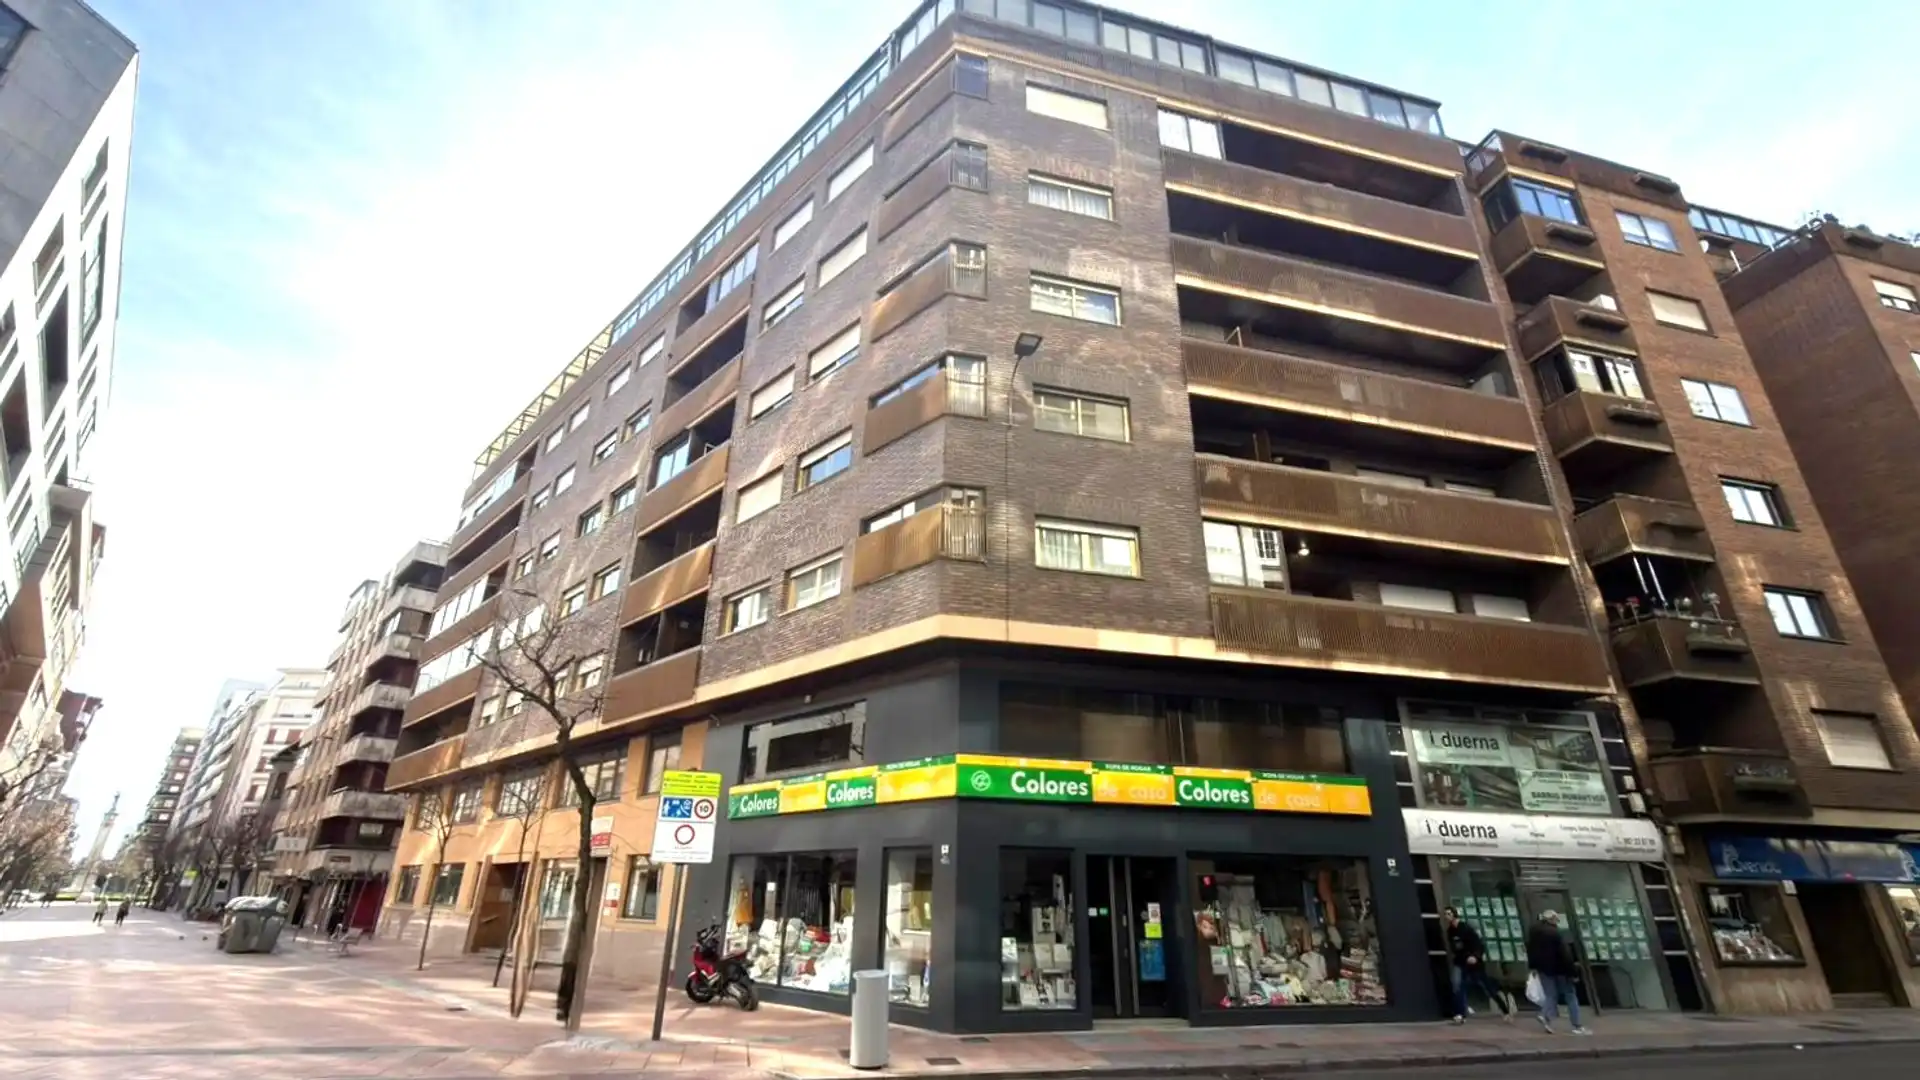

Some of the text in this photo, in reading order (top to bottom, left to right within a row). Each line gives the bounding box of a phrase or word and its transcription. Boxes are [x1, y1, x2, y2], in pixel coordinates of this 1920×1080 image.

[1441, 730, 1501, 750] duerna
[826, 781, 874, 803] Colores
[1011, 770, 1089, 796] Colores
[1179, 779, 1250, 805] Colores
[699, 804, 710, 814] 10
[739, 794, 778, 813] Colores
[1438, 819, 1498, 840] duerna
